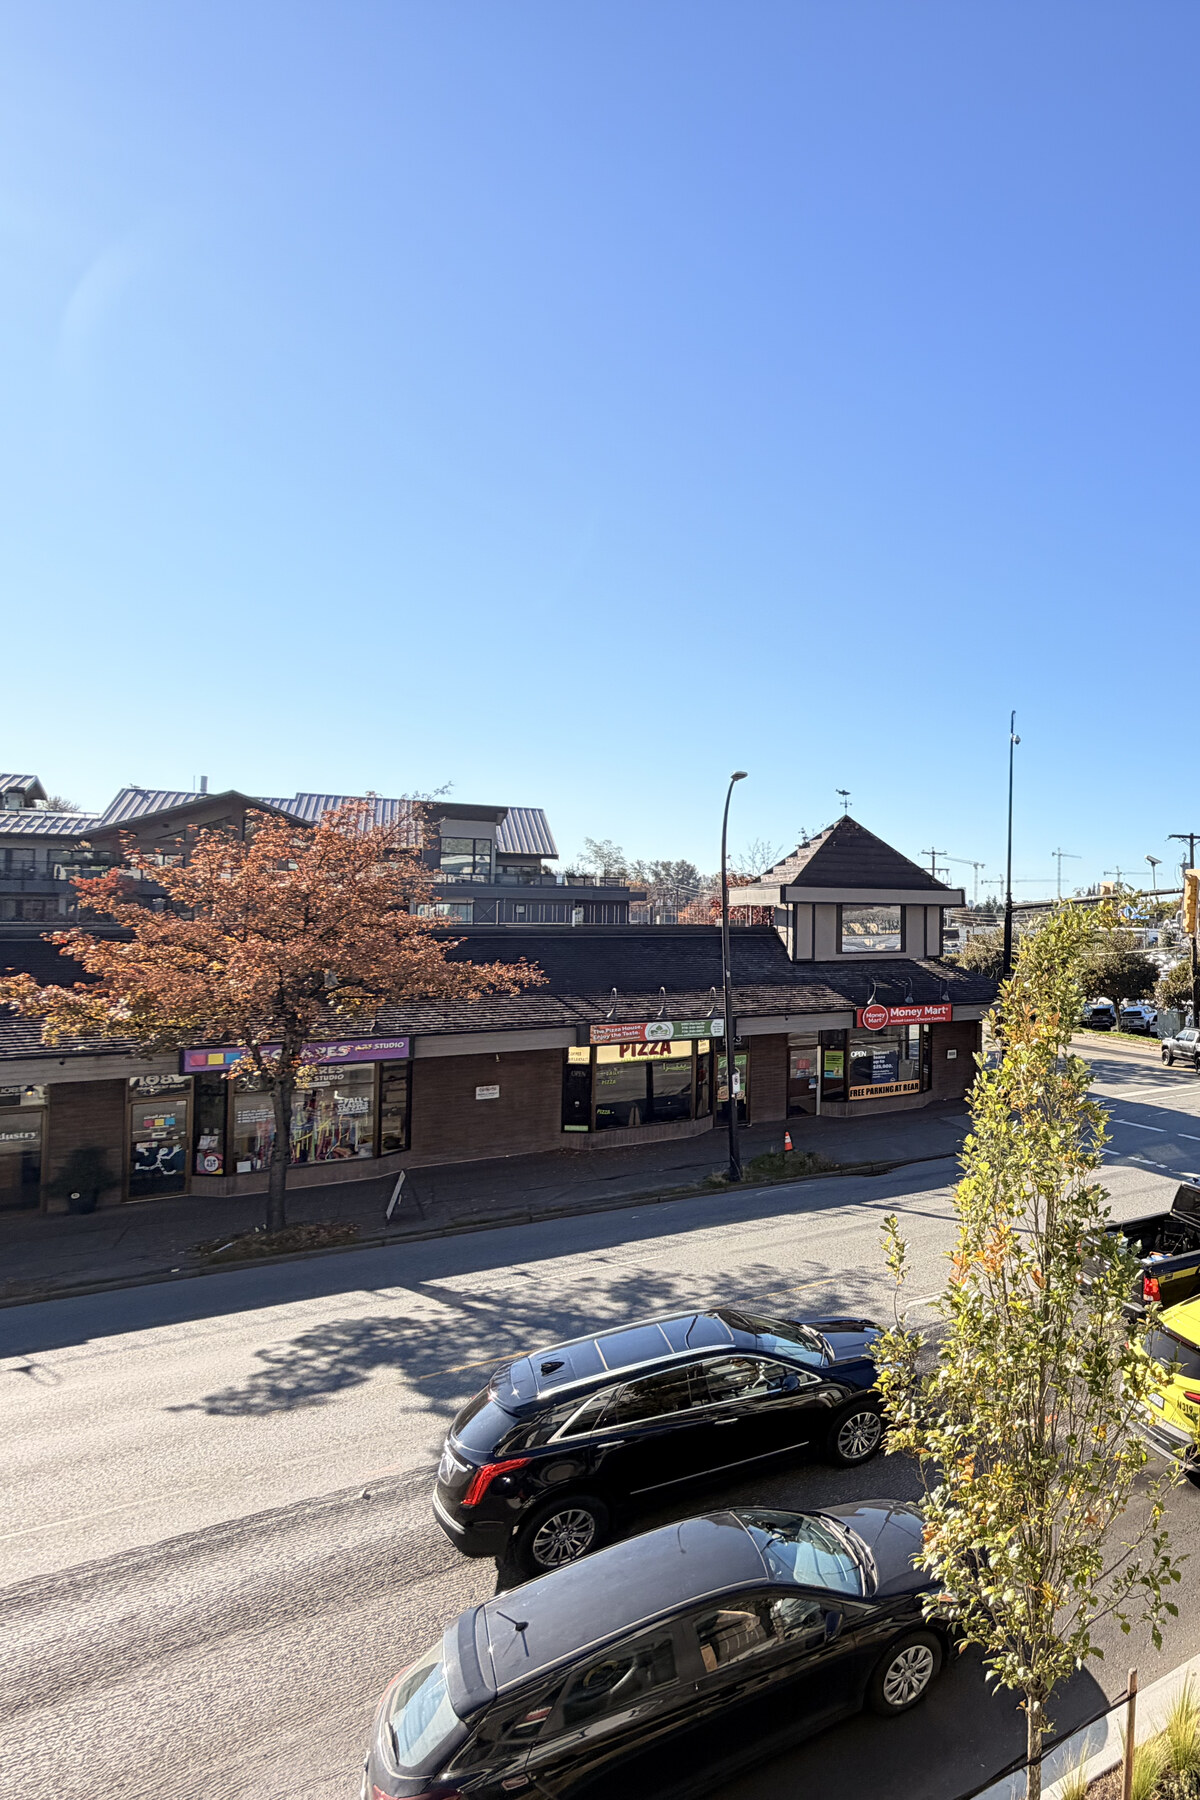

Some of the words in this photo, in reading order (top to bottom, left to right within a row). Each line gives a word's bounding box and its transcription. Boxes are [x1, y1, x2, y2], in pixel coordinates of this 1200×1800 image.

[890, 1007, 922, 1018] Money
[924, 1005, 946, 1015] Mart
[374, 1041, 405, 1050] STUDIO
[619, 1041, 672, 1058] PIZZA
[850, 1050, 867, 1058] OPEN
[314, 1074, 345, 1082] STUDIO
[850, 1088, 865, 1097] FREE
[865, 1085, 894, 1096] PARKING
[894, 1084, 903, 1092] AT
[902, 1082, 919, 1091] REAR
